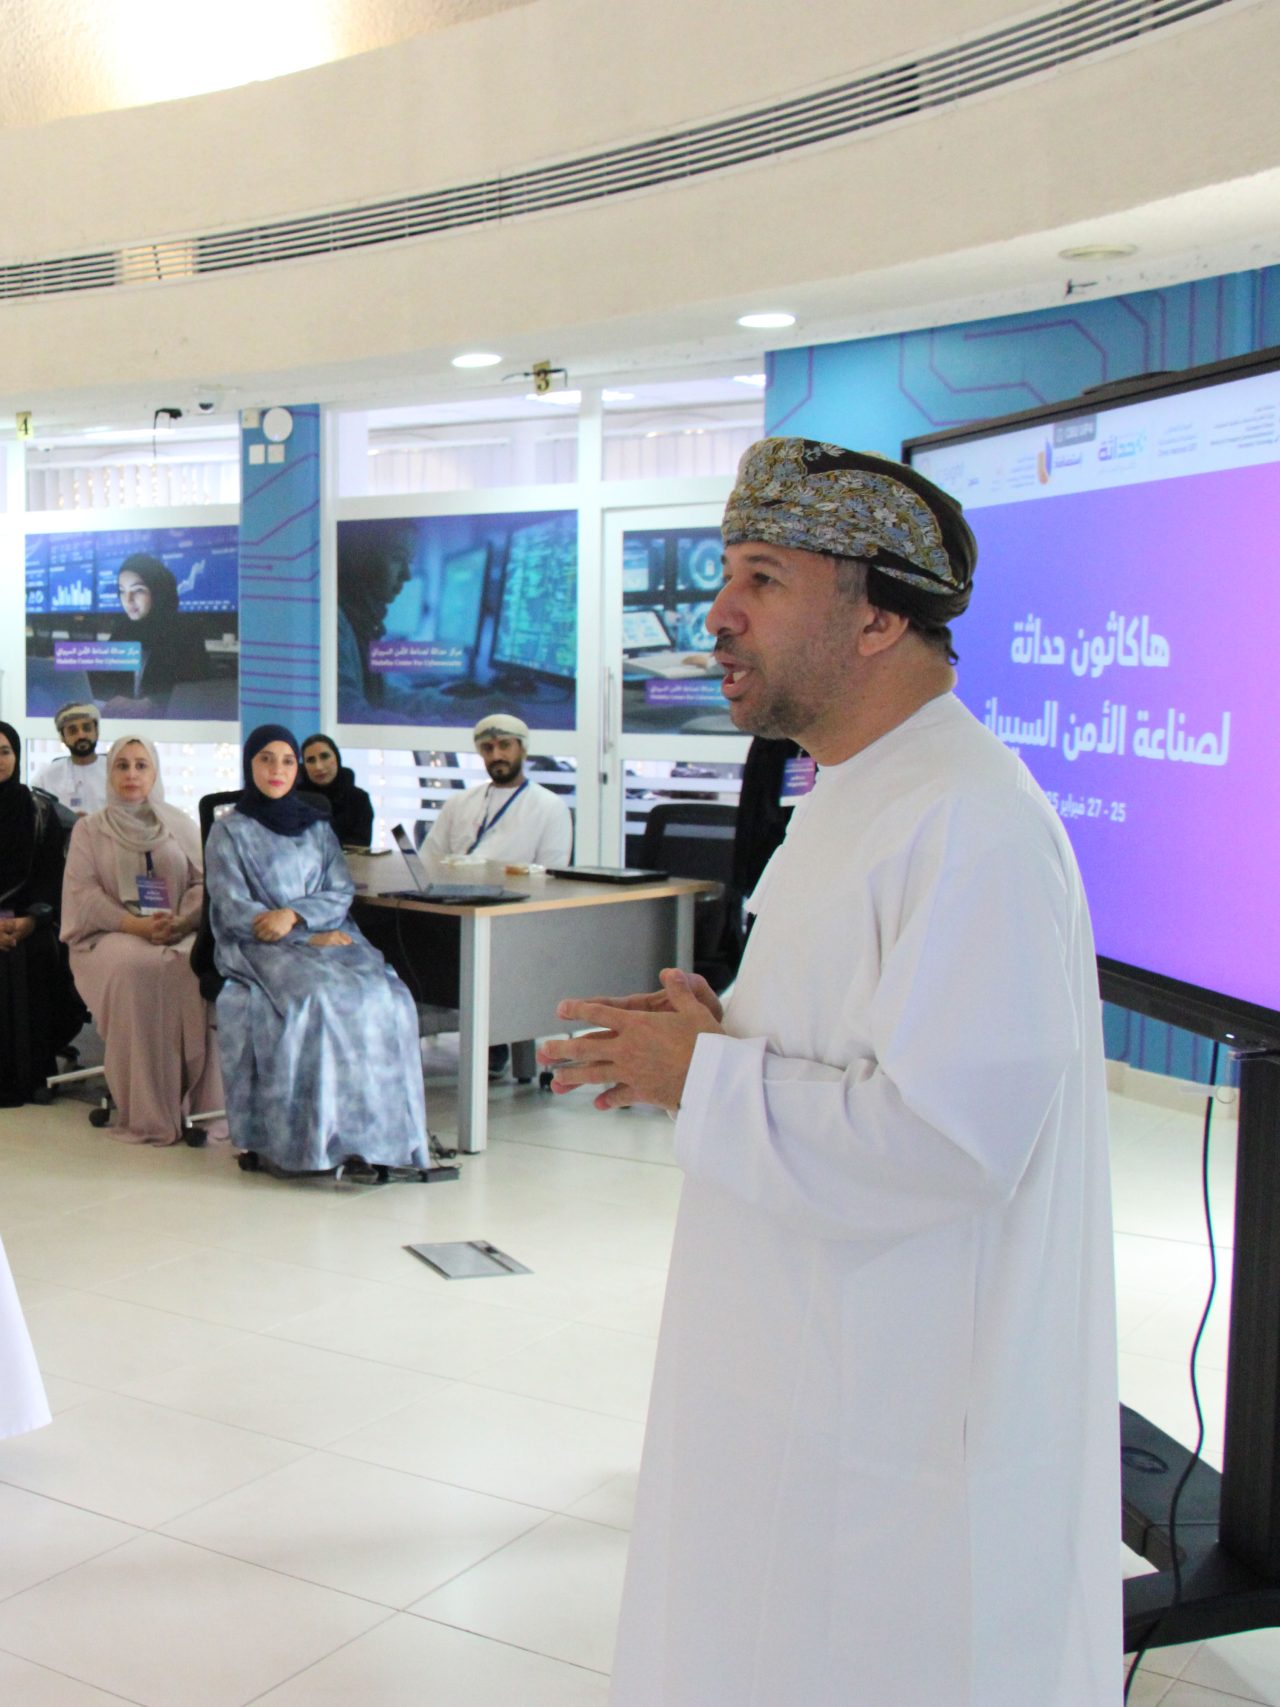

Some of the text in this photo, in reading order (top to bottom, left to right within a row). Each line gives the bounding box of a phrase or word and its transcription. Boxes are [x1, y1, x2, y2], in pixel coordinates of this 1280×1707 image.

[18, 416, 29, 435] 4
[1011, 610, 1170, 678] هاكاثون حداثة
[1062, 700, 1127, 761] الأمن
[1132, 707, 1231, 766] لصناعة
[1060, 793, 1086, 820] فبراير
[1087, 797, 1102, 817] 27
[1110, 801, 1126, 822] 25
